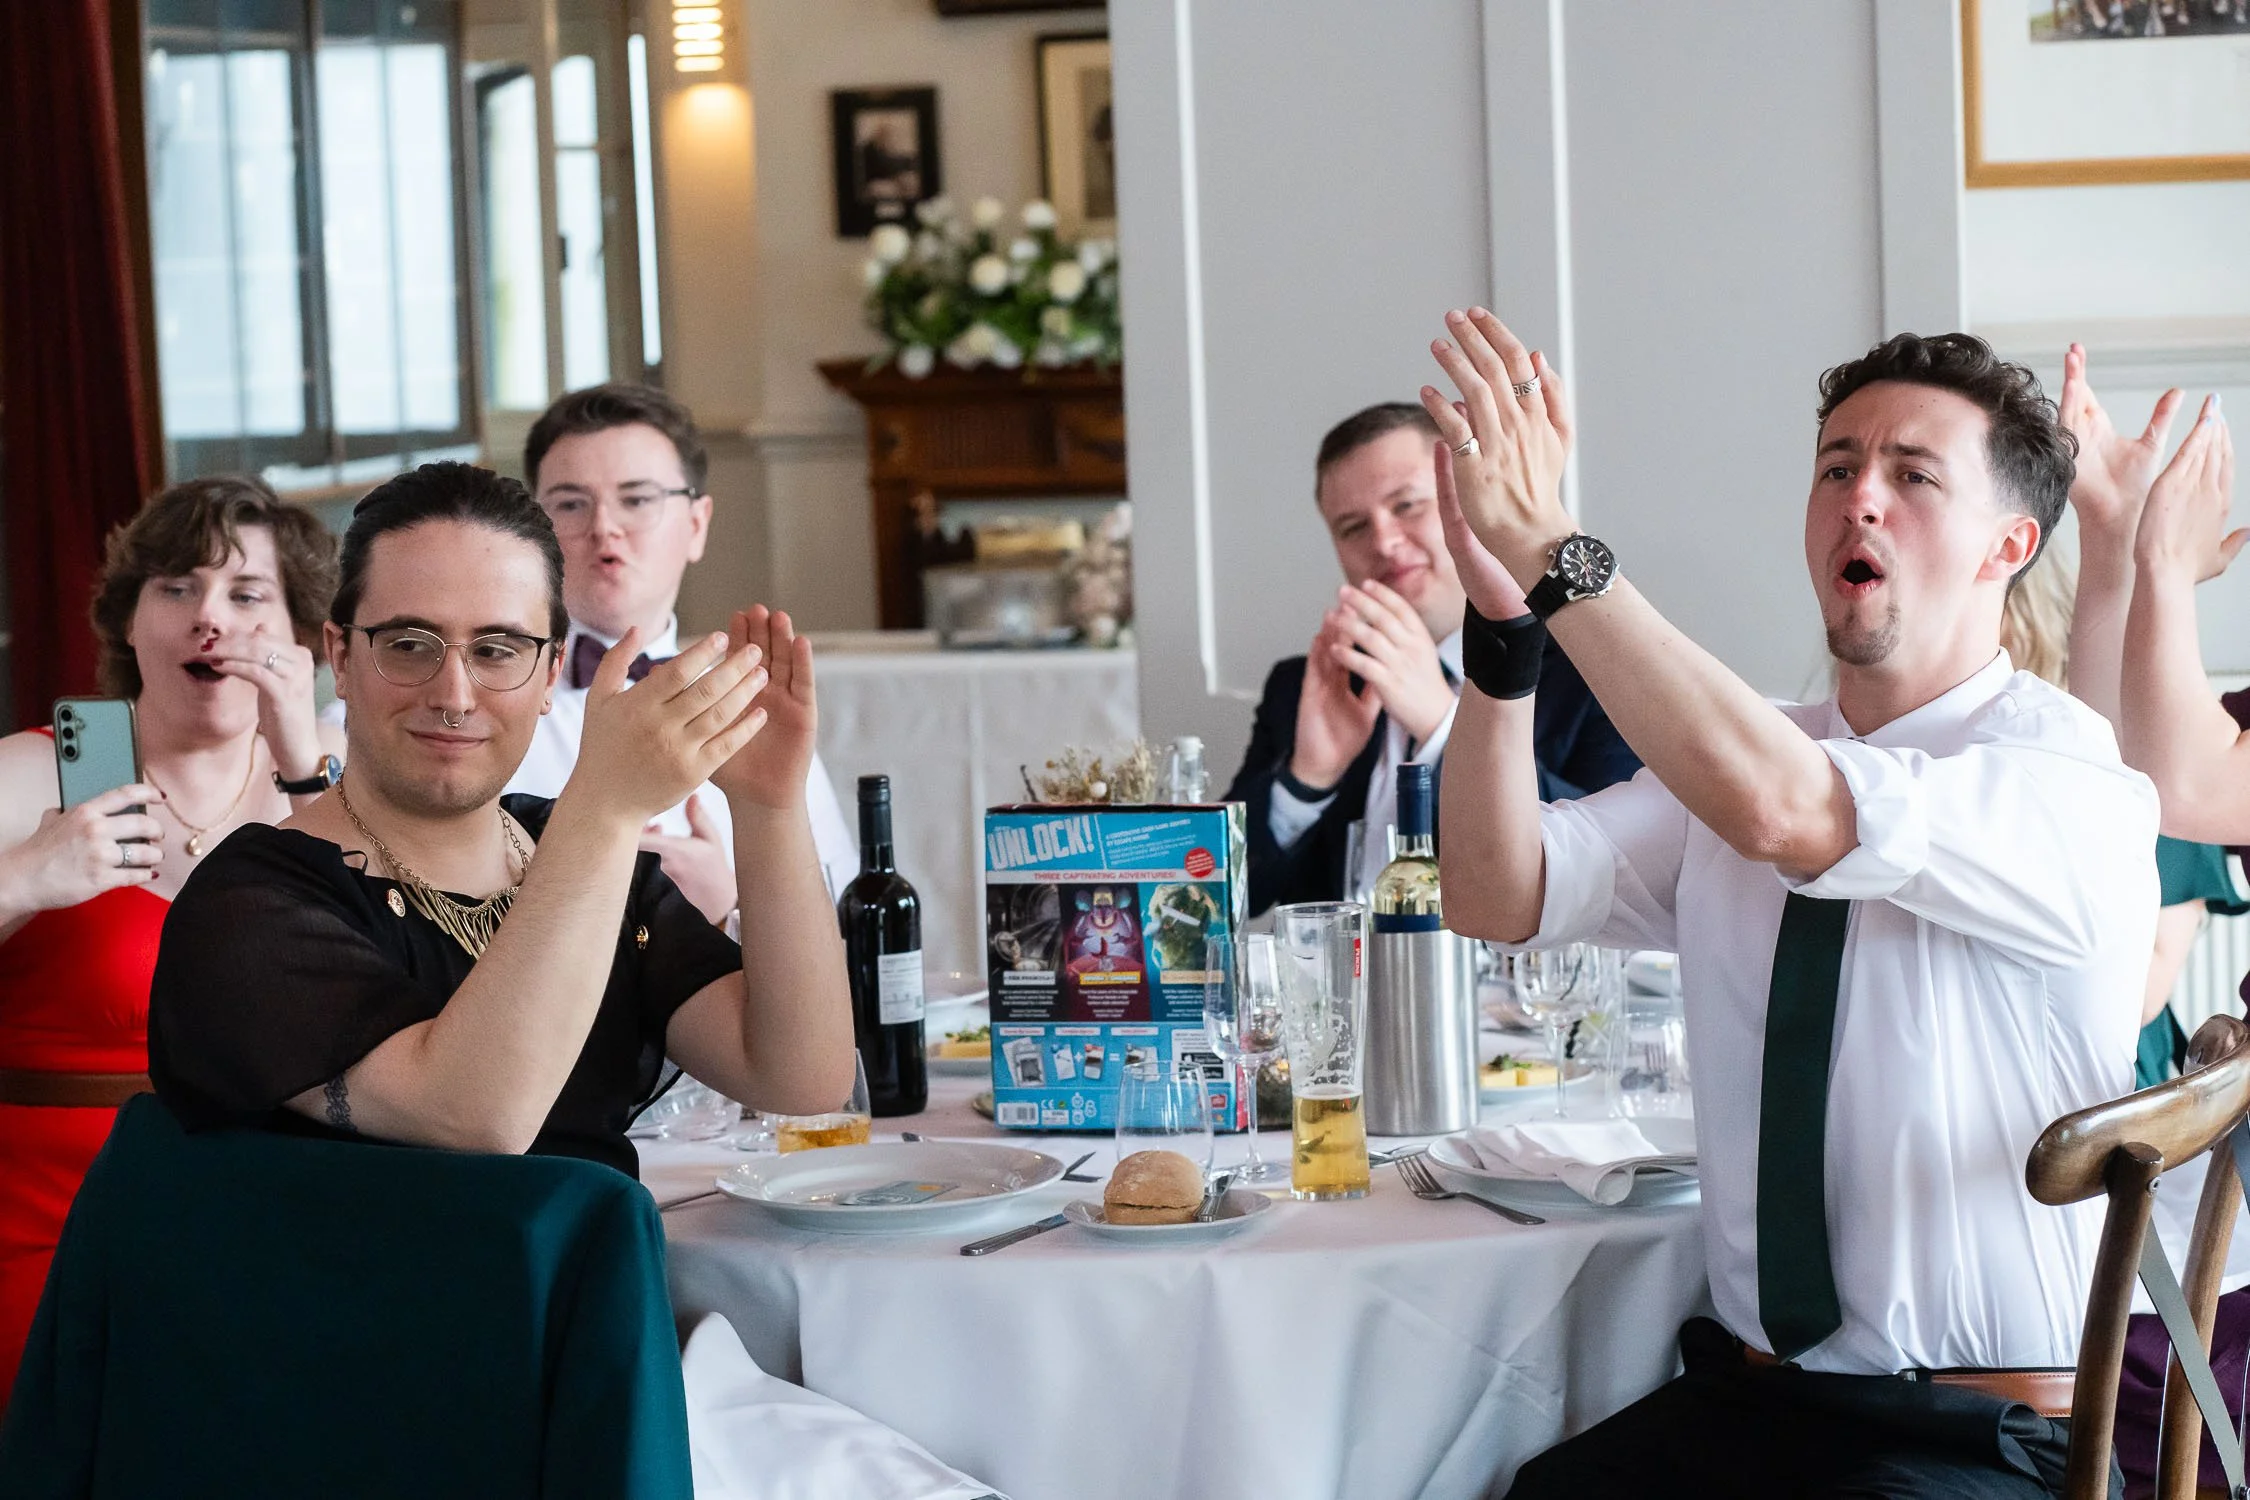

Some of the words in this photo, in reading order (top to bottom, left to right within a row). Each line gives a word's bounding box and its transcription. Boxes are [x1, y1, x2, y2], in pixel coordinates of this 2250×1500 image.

[987, 815, 1095, 870] UNLOCK!
[1034, 872, 1060, 881] THREE
[1063, 872, 1117, 881] CAPTIVATING
[1118, 871, 1177, 880] ADVENTURES!
